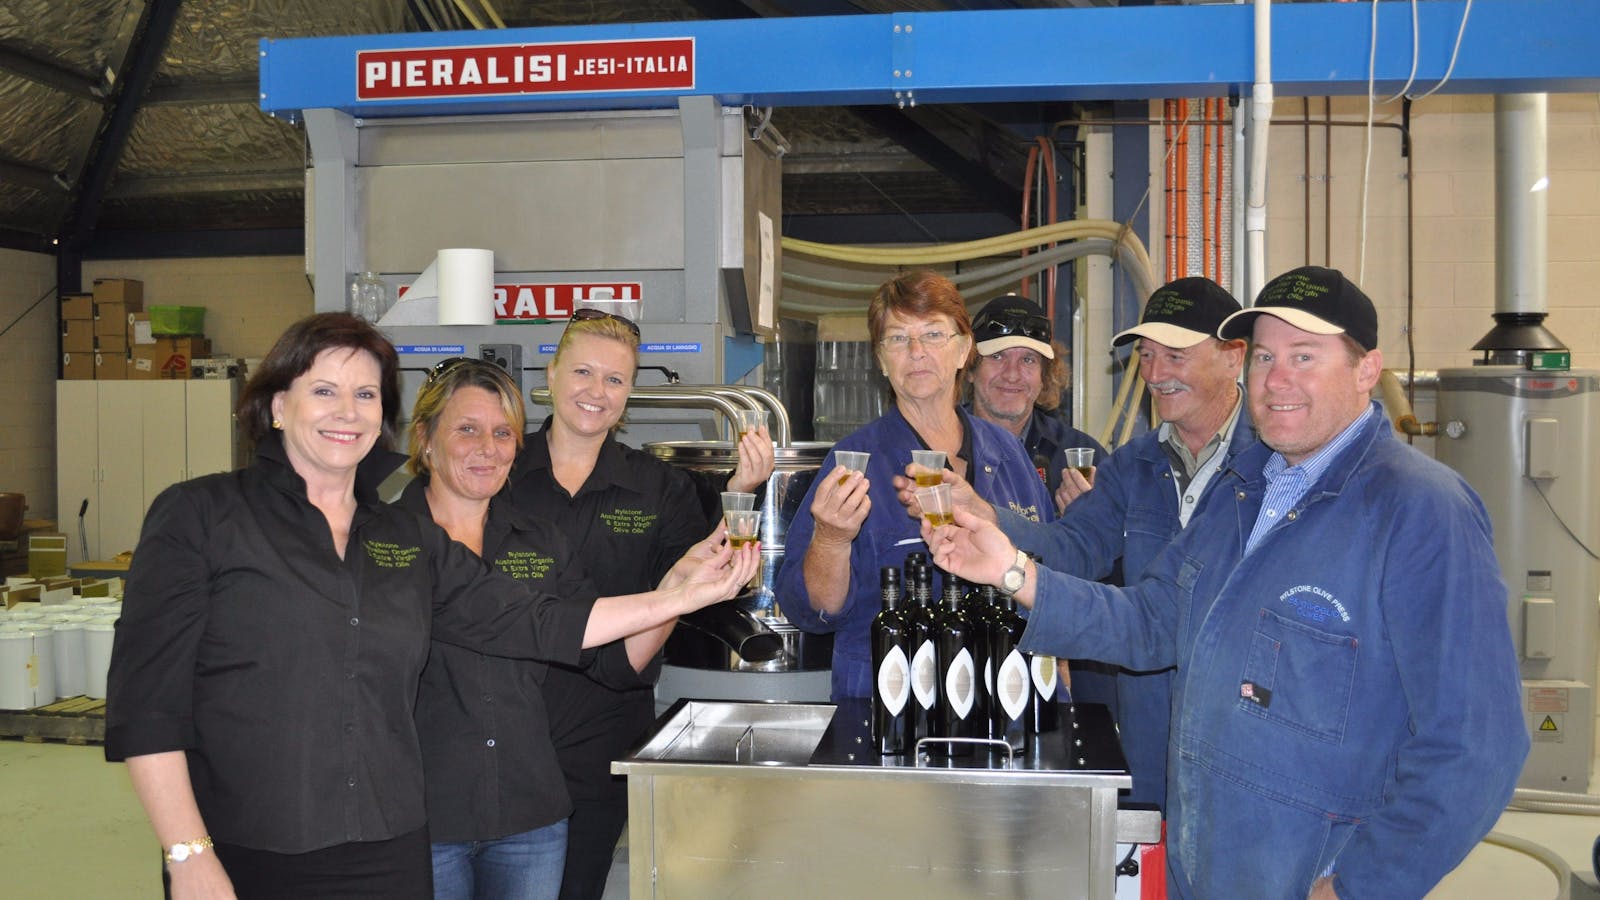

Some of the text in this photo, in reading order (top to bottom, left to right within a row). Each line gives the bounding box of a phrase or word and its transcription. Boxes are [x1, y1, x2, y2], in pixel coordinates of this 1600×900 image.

[365, 54, 688, 89] PIERALISI JESI-ITALIA
[1280, 585, 1351, 622] RYLSTONE OLIVE PRESS
